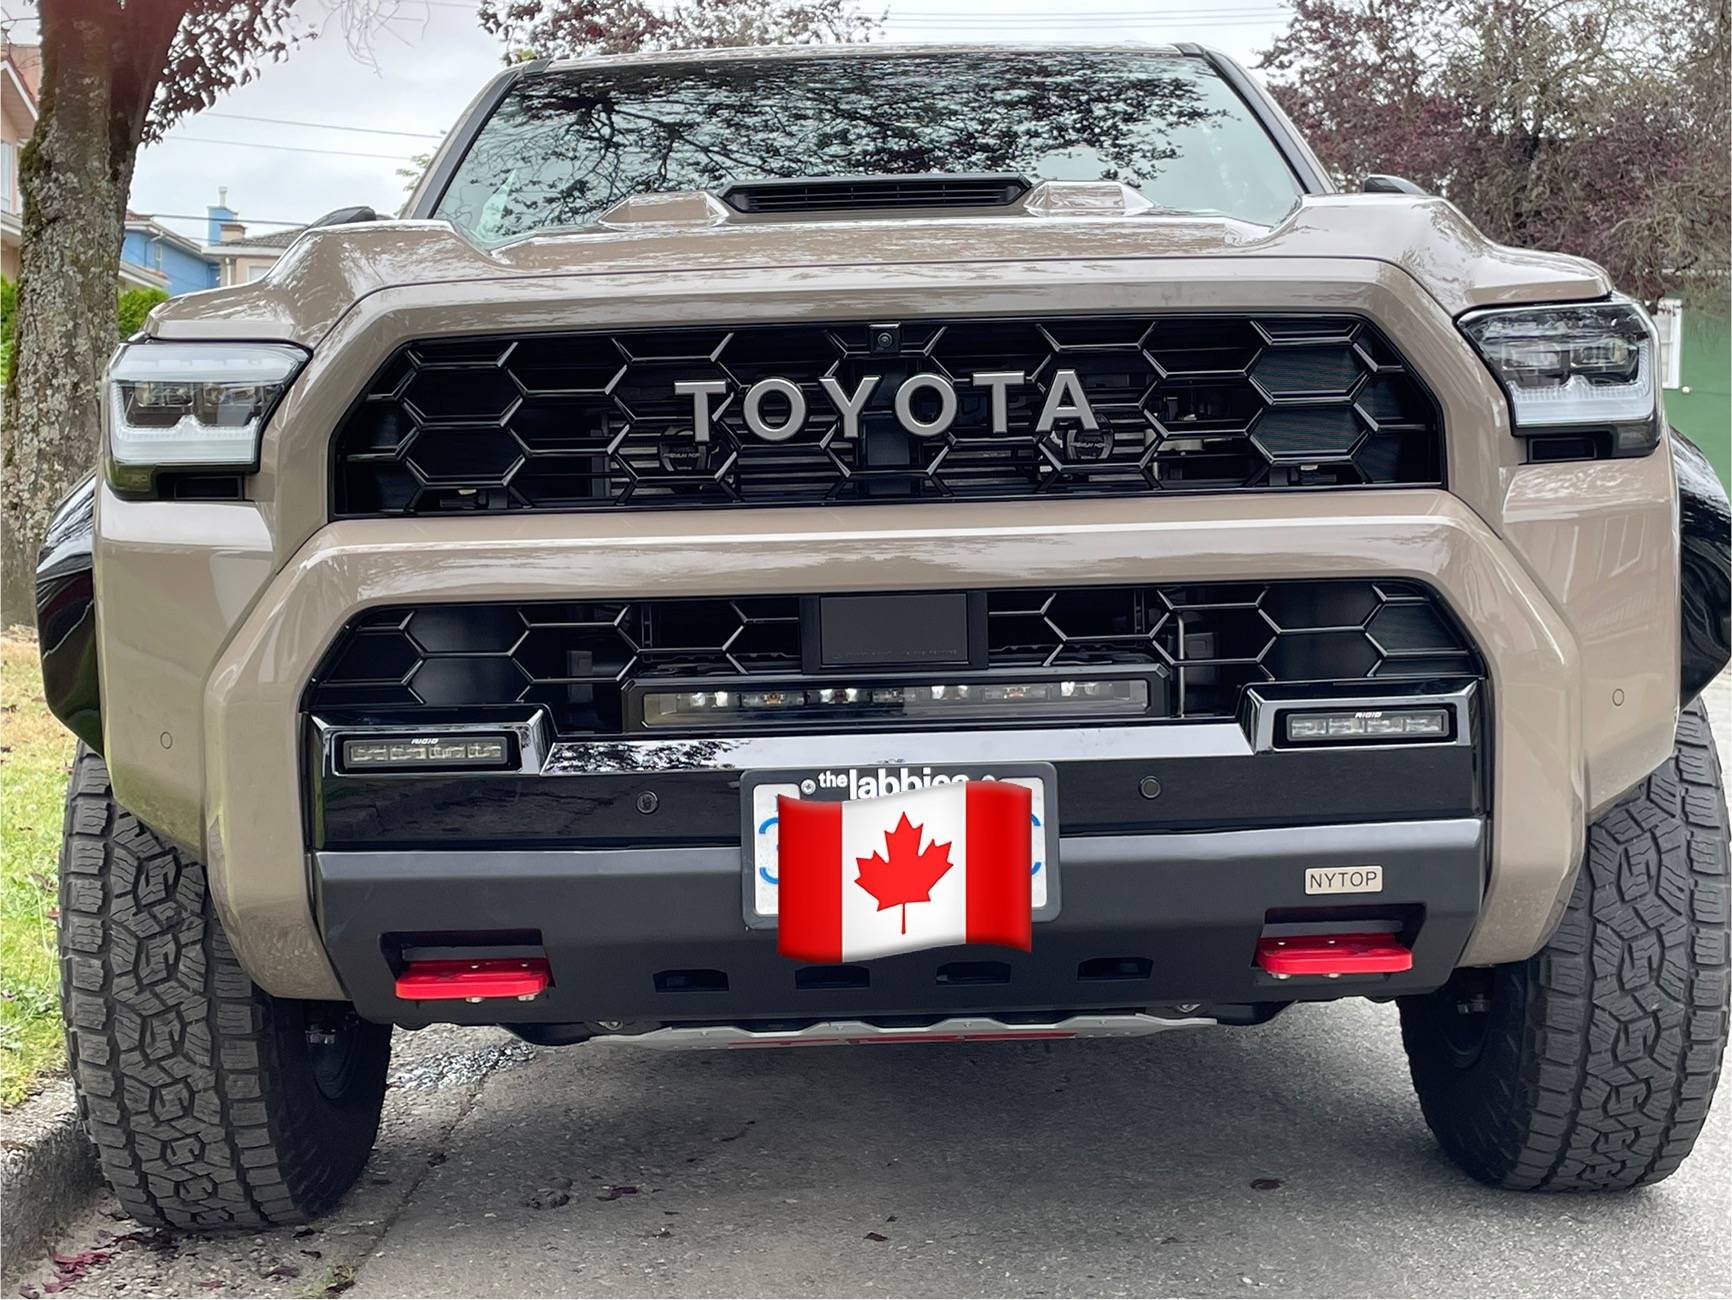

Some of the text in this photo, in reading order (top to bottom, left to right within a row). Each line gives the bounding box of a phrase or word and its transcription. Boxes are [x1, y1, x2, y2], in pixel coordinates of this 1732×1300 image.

[674, 368, 1099, 443] TOYOTA
[817, 770, 848, 790] the
[1310, 871, 1377, 889] NYTOP
